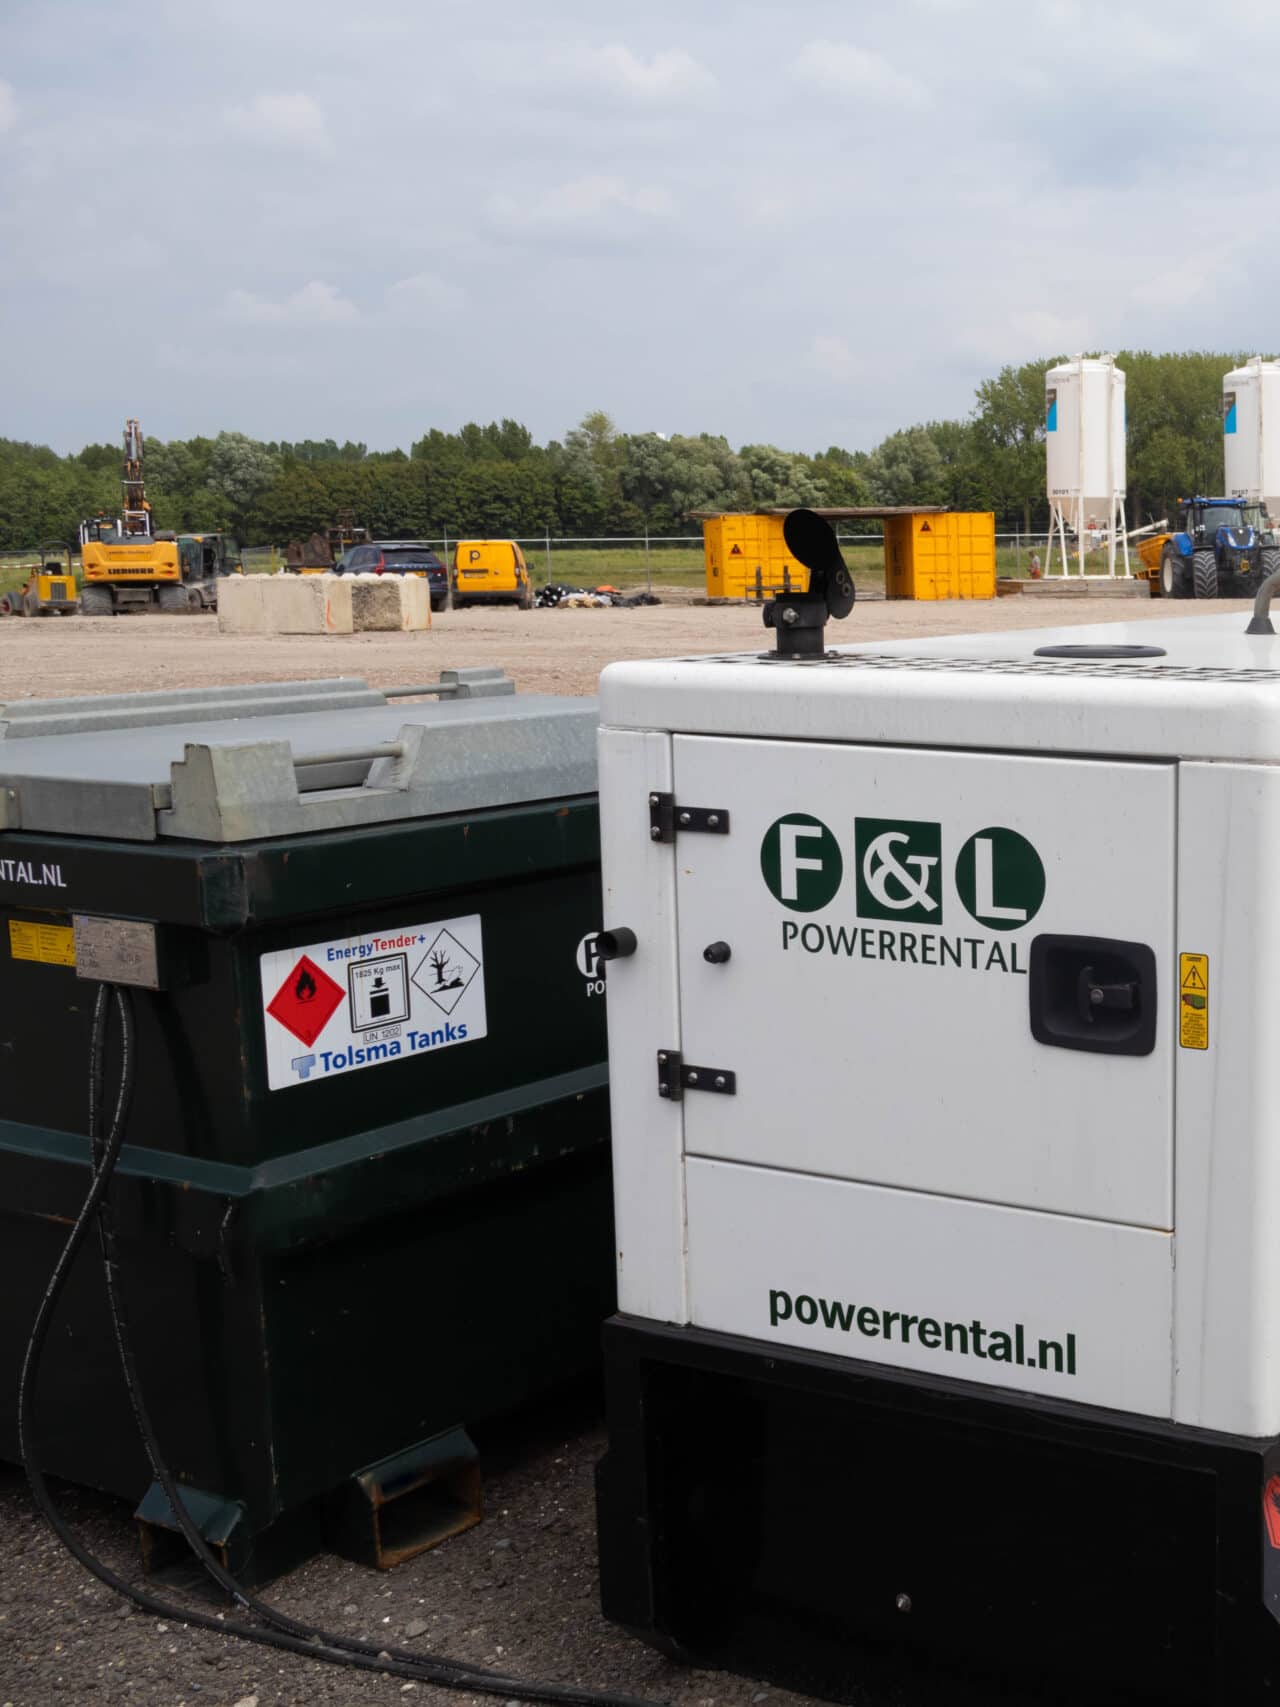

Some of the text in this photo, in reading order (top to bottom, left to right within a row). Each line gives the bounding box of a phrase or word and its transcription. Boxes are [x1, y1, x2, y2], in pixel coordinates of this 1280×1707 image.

[326, 934, 426, 962] EnergyTender+
[781, 920, 1028, 975] POWERRENTAL
[386, 963, 401, 973] max
[586, 979, 605, 997] PO
[320, 1022, 469, 1072] Tolsma Tanks
[768, 1288, 1077, 1376] powerrental.nl
